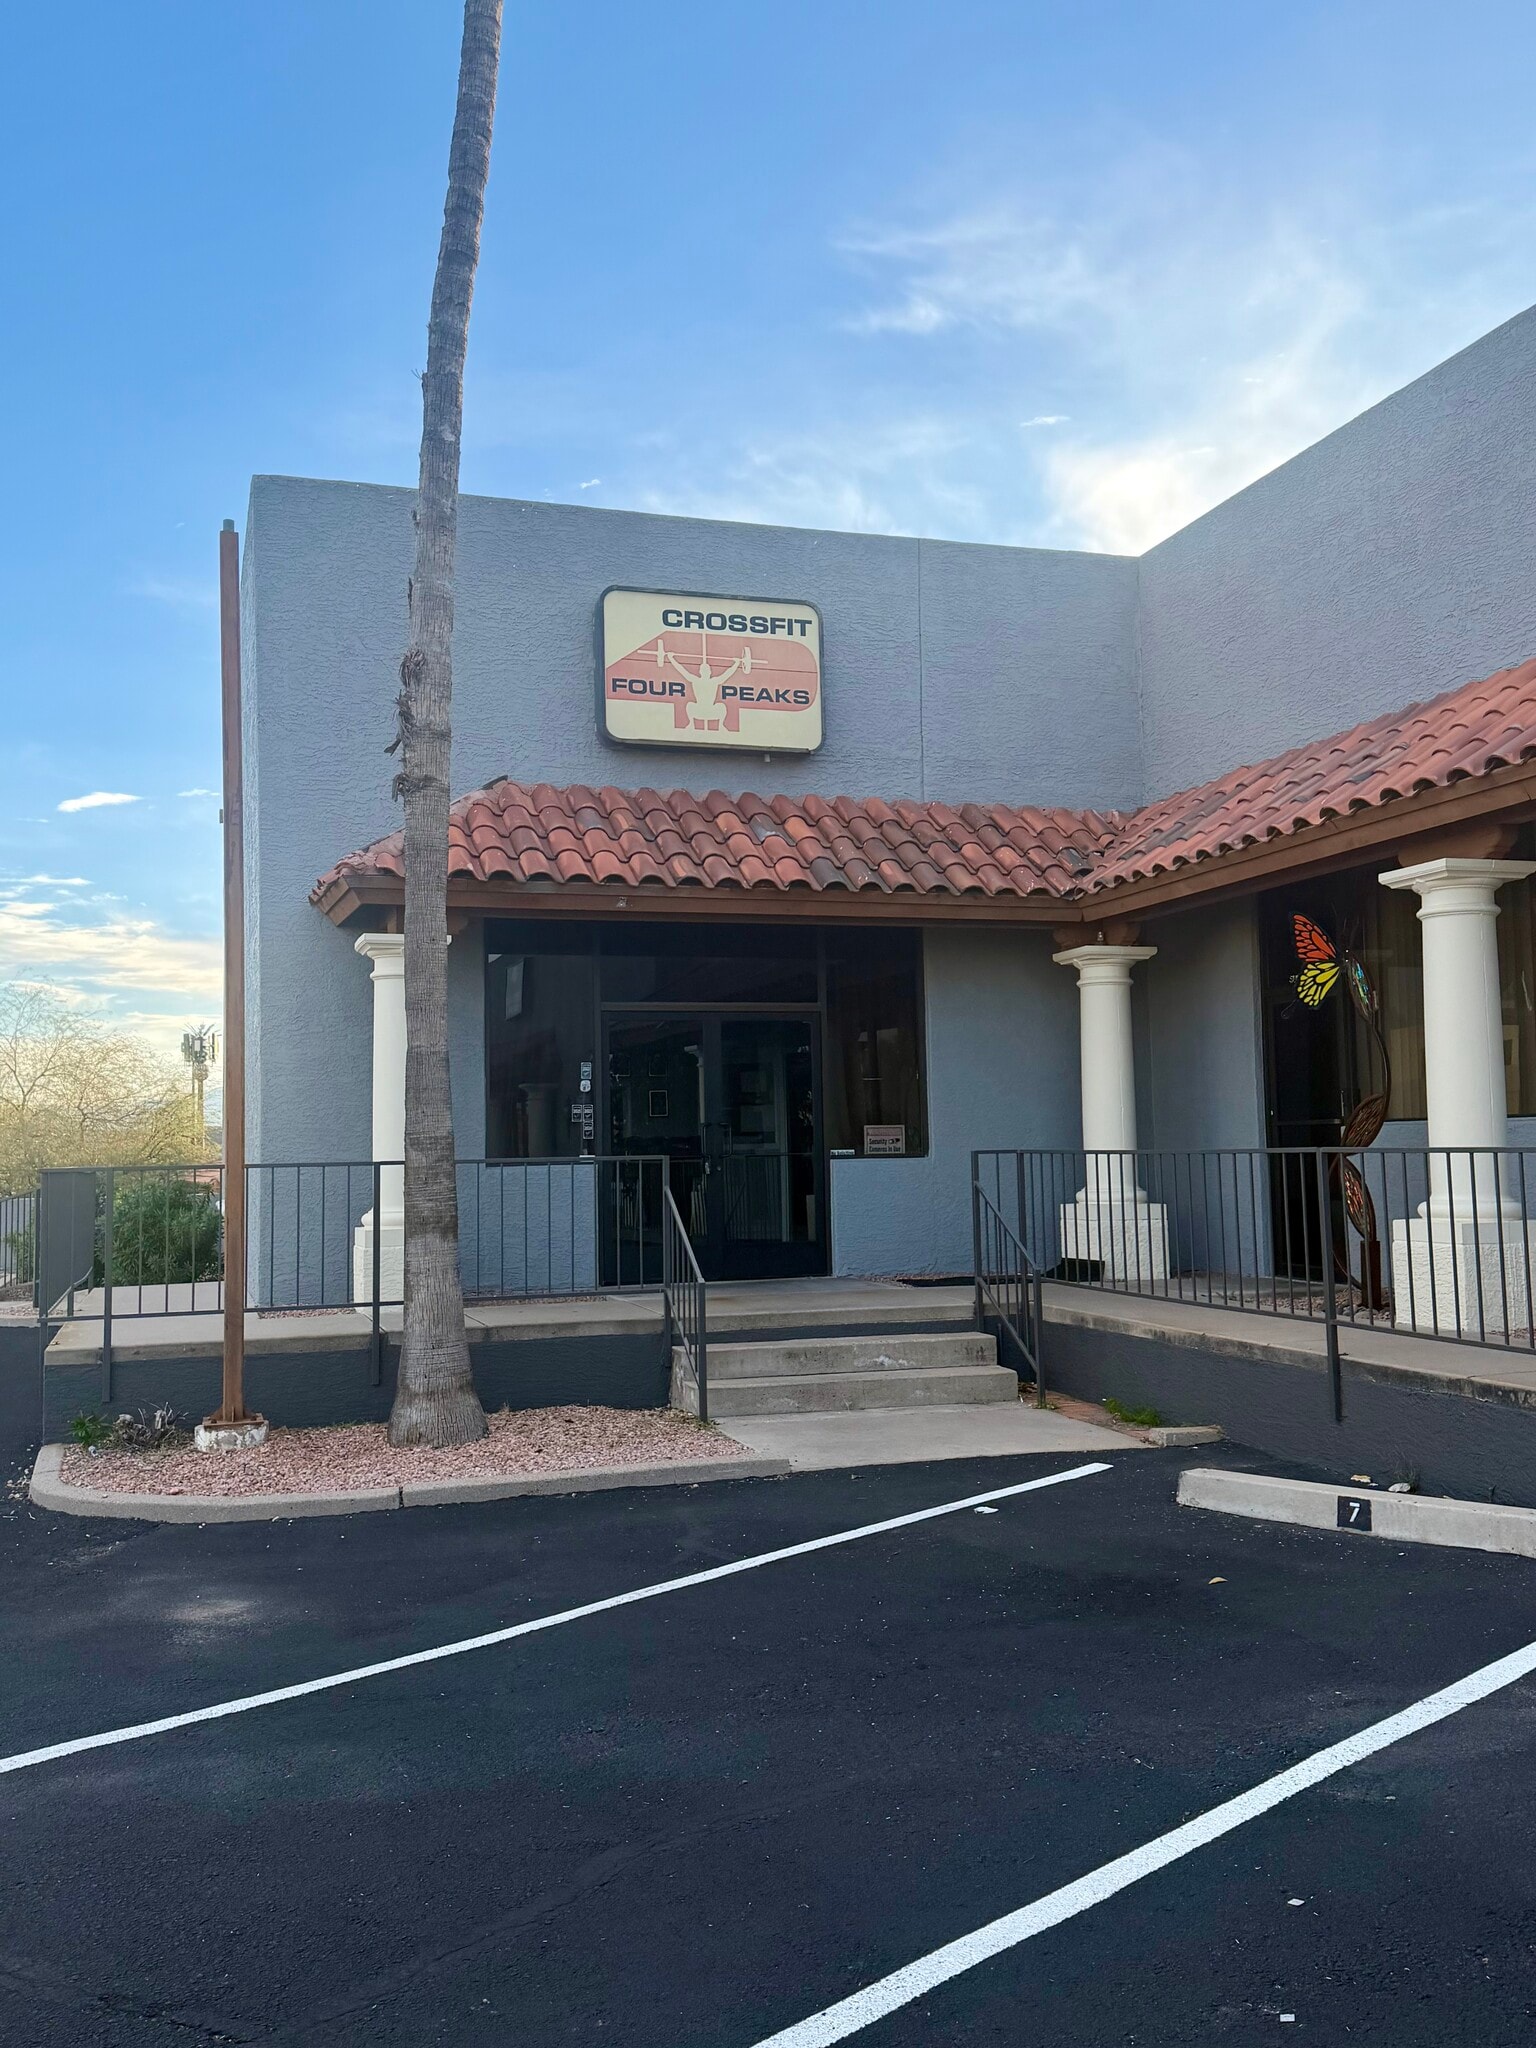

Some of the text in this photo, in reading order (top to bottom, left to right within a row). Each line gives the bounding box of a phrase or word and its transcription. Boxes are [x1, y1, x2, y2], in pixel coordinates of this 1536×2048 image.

[662, 609, 812, 637] CROSSFIT
[611, 677, 810, 705] FOUR PEAKS
[1349, 1502, 1360, 1522] 7
